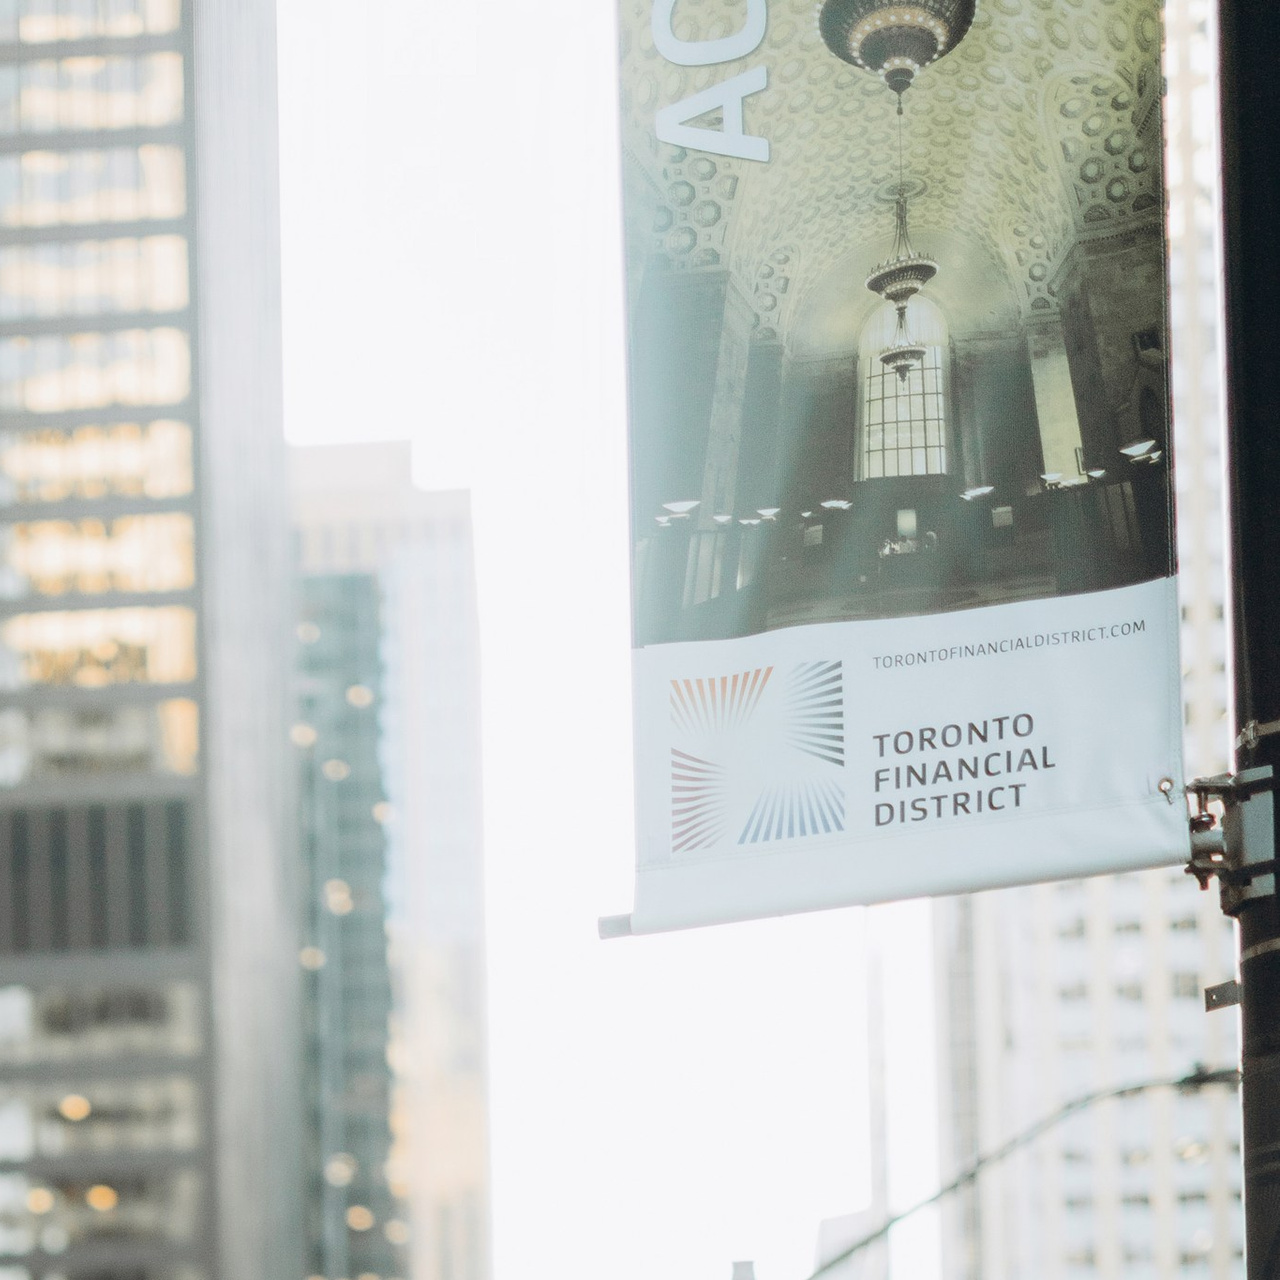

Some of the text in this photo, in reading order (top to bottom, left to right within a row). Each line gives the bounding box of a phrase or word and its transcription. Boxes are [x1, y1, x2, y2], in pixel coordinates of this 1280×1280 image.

[872, 619, 1146, 670] TORONTOFINANCIALDISTRICT.COM
[872, 712, 1035, 758] TORONTO
[873, 746, 1057, 793] FINANCIAL
[874, 783, 1028, 827] DISTRICT
